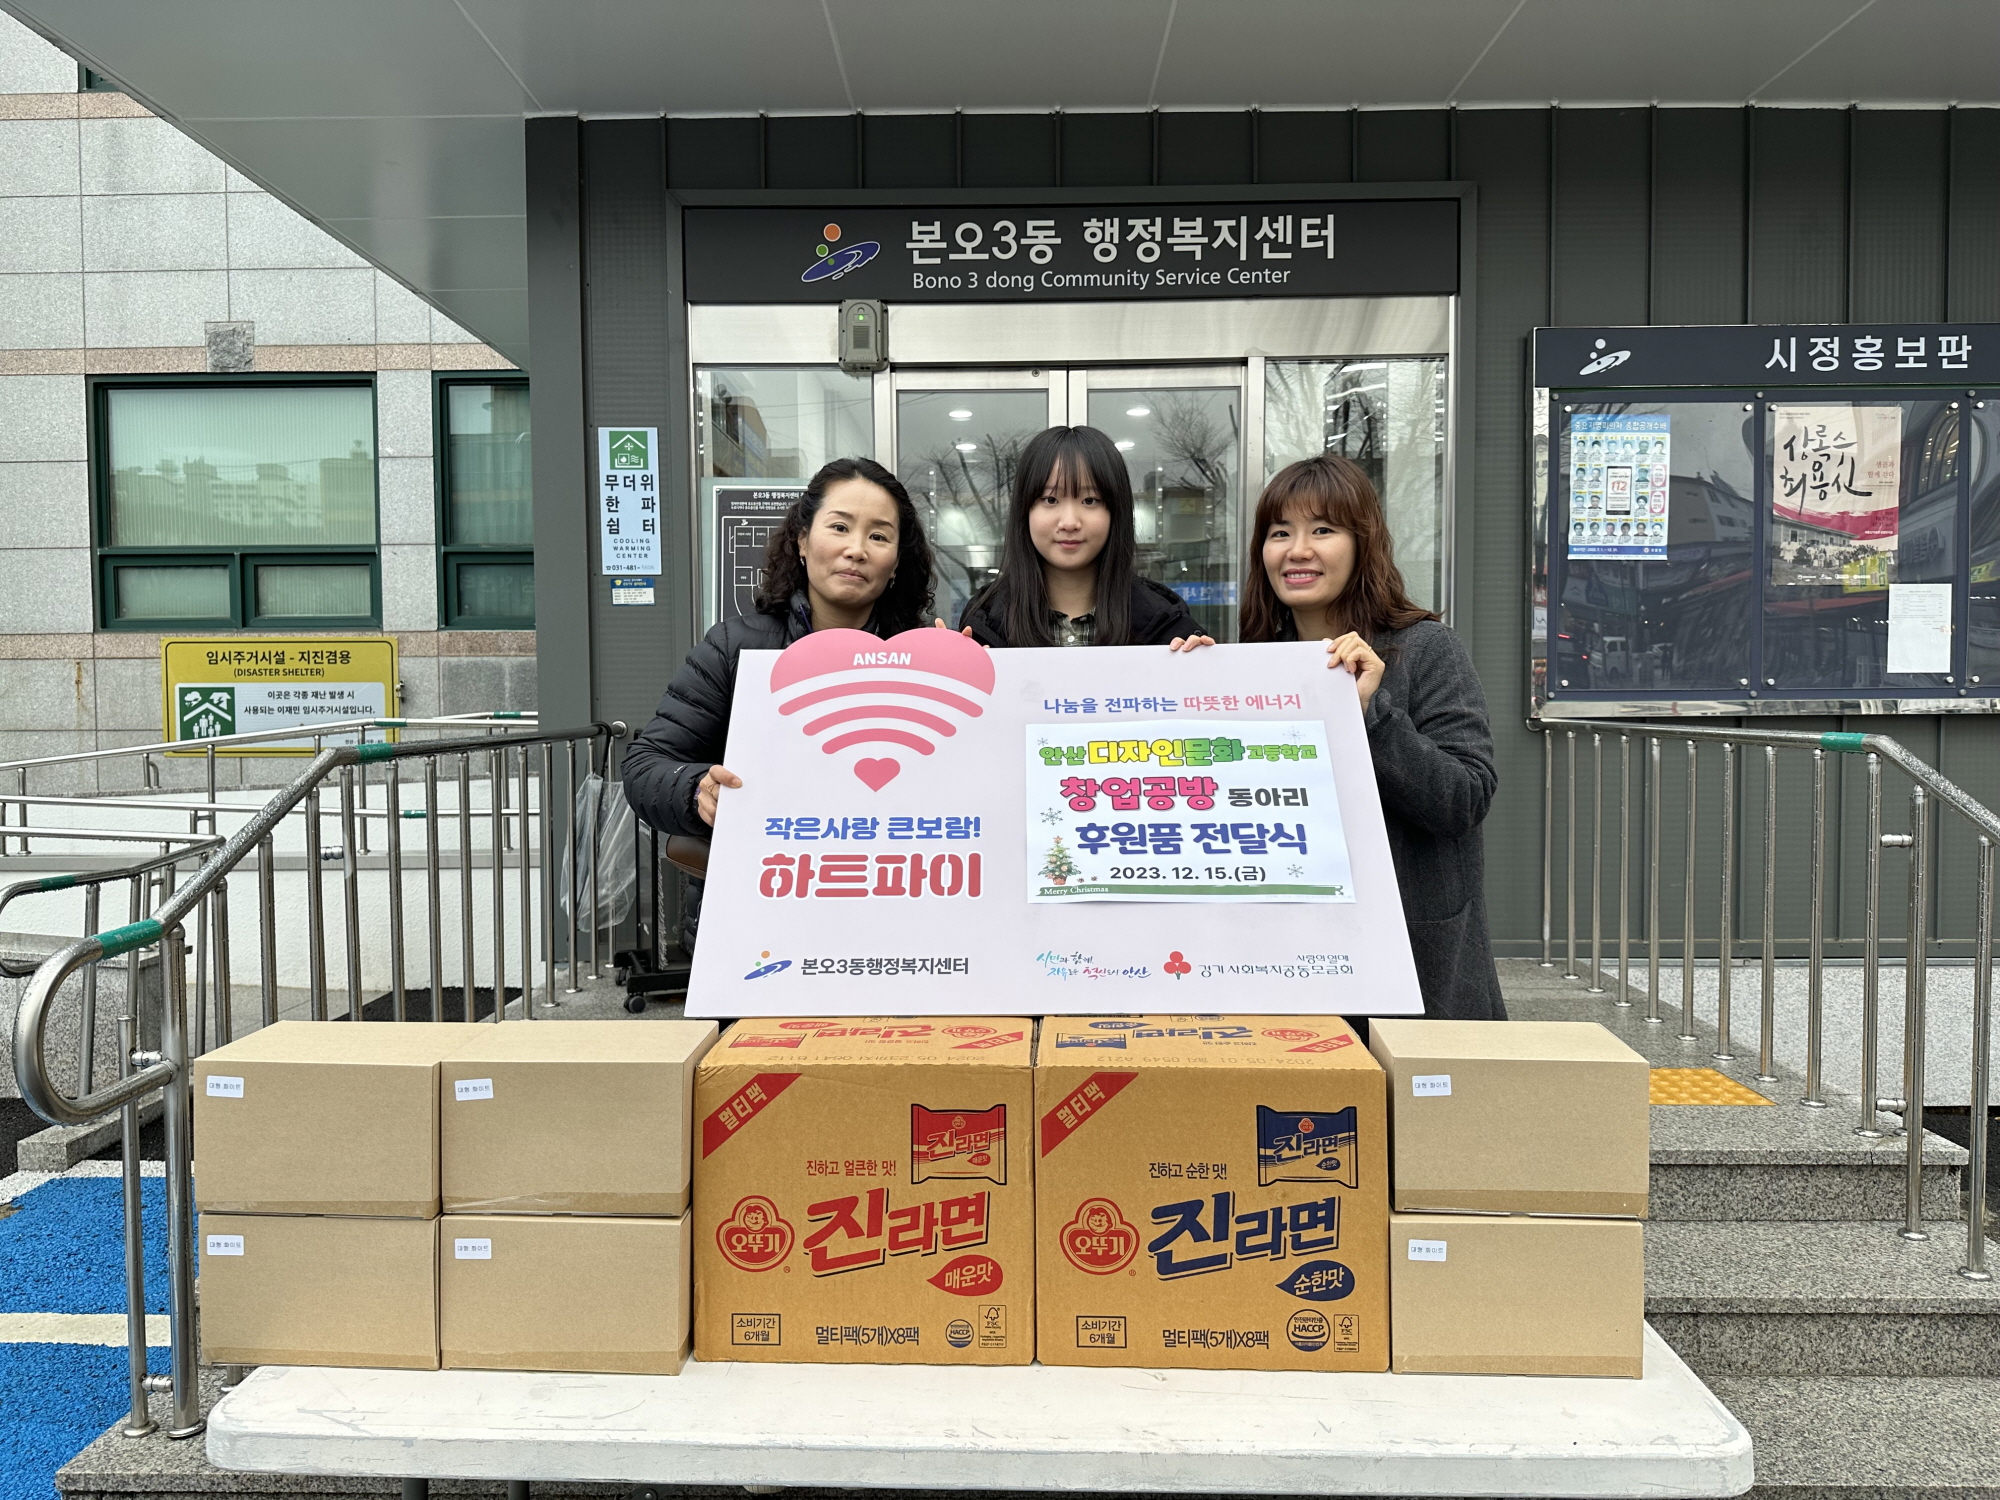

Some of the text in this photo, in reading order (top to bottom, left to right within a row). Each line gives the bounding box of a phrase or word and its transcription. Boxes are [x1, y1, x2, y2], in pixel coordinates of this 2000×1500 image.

[905, 213, 1335, 265] 본오3동 행정복지센터
[912, 267, 1291, 291] Bono 3 dong Community Service Center
[1764, 335, 1973, 372] 시정홍보판
[1867, 471, 1895, 479] 함께 걷다
[1611, 481, 1628, 491] 112
[206, 650, 286, 665] 임시주거시설
[298, 650, 352, 664] 지진겸용
[853, 652, 912, 666] ANSAN
[233, 668, 325, 677] (DISASTER SHELTER)
[267, 691, 291, 699] 이곳은
[310, 691, 327, 699] 재난
[329, 691, 345, 699] 발생
[347, 691, 355, 699] 시
[1044, 693, 1302, 714] 나눔을 전파하는 따뜻한 에너지
[244, 704, 376, 715] 사용되는 이재민 임시주거시설입니다.
[1060, 776, 1309, 812] 창업공방 동아리
[764, 816, 982, 840] 작은사랑 큰보람!
[1075, 822, 1307, 855] 후원품 전달식
[757, 852, 985, 900] 하트파이
[1109, 865, 1266, 882] 2023. 12. 15.(금)
[1044, 885, 1109, 896] Merry Christmas
[801, 957, 970, 975] 본오3동행정복지센터
[1036, 950, 1070, 968] 시민과
[1122, 966, 1152, 978] 안산
[812, 1025, 935, 1038] 진라면
[1132, 1026, 1253, 1040] 진라면
[717, 1082, 768, 1131] 멀티팩
[1056, 1081, 1106, 1130] 멀티팩
[926, 1128, 990, 1162] 진라면
[1273, 1133, 1339, 1164] 진라면
[806, 1159, 897, 1177] 진하고 얼큰한 맛!
[1149, 1163, 1228, 1179] 진하고 순한 맛!
[803, 1188, 990, 1278] 진라면
[1147, 1191, 1341, 1281] 진라면
[730, 1233, 781, 1254] 오뚜기
[1075, 1236, 1125, 1256] 오뚜기
[945, 1262, 994, 1289] 매운맛
[1293, 1267, 1345, 1295] 순한맛
[736, 1317, 776, 1330] 소비기간
[1081, 1319, 1122, 1332] 소비기간
[1293, 1324, 1324, 1332] HACCP
[743, 1330, 770, 1343] 6개월
[815, 1326, 920, 1346] 멀티팩(5개)X8팩
[1089, 1331, 1116, 1344] 6개월
[1162, 1329, 1270, 1350] 멀티팩(5개)X8팩
